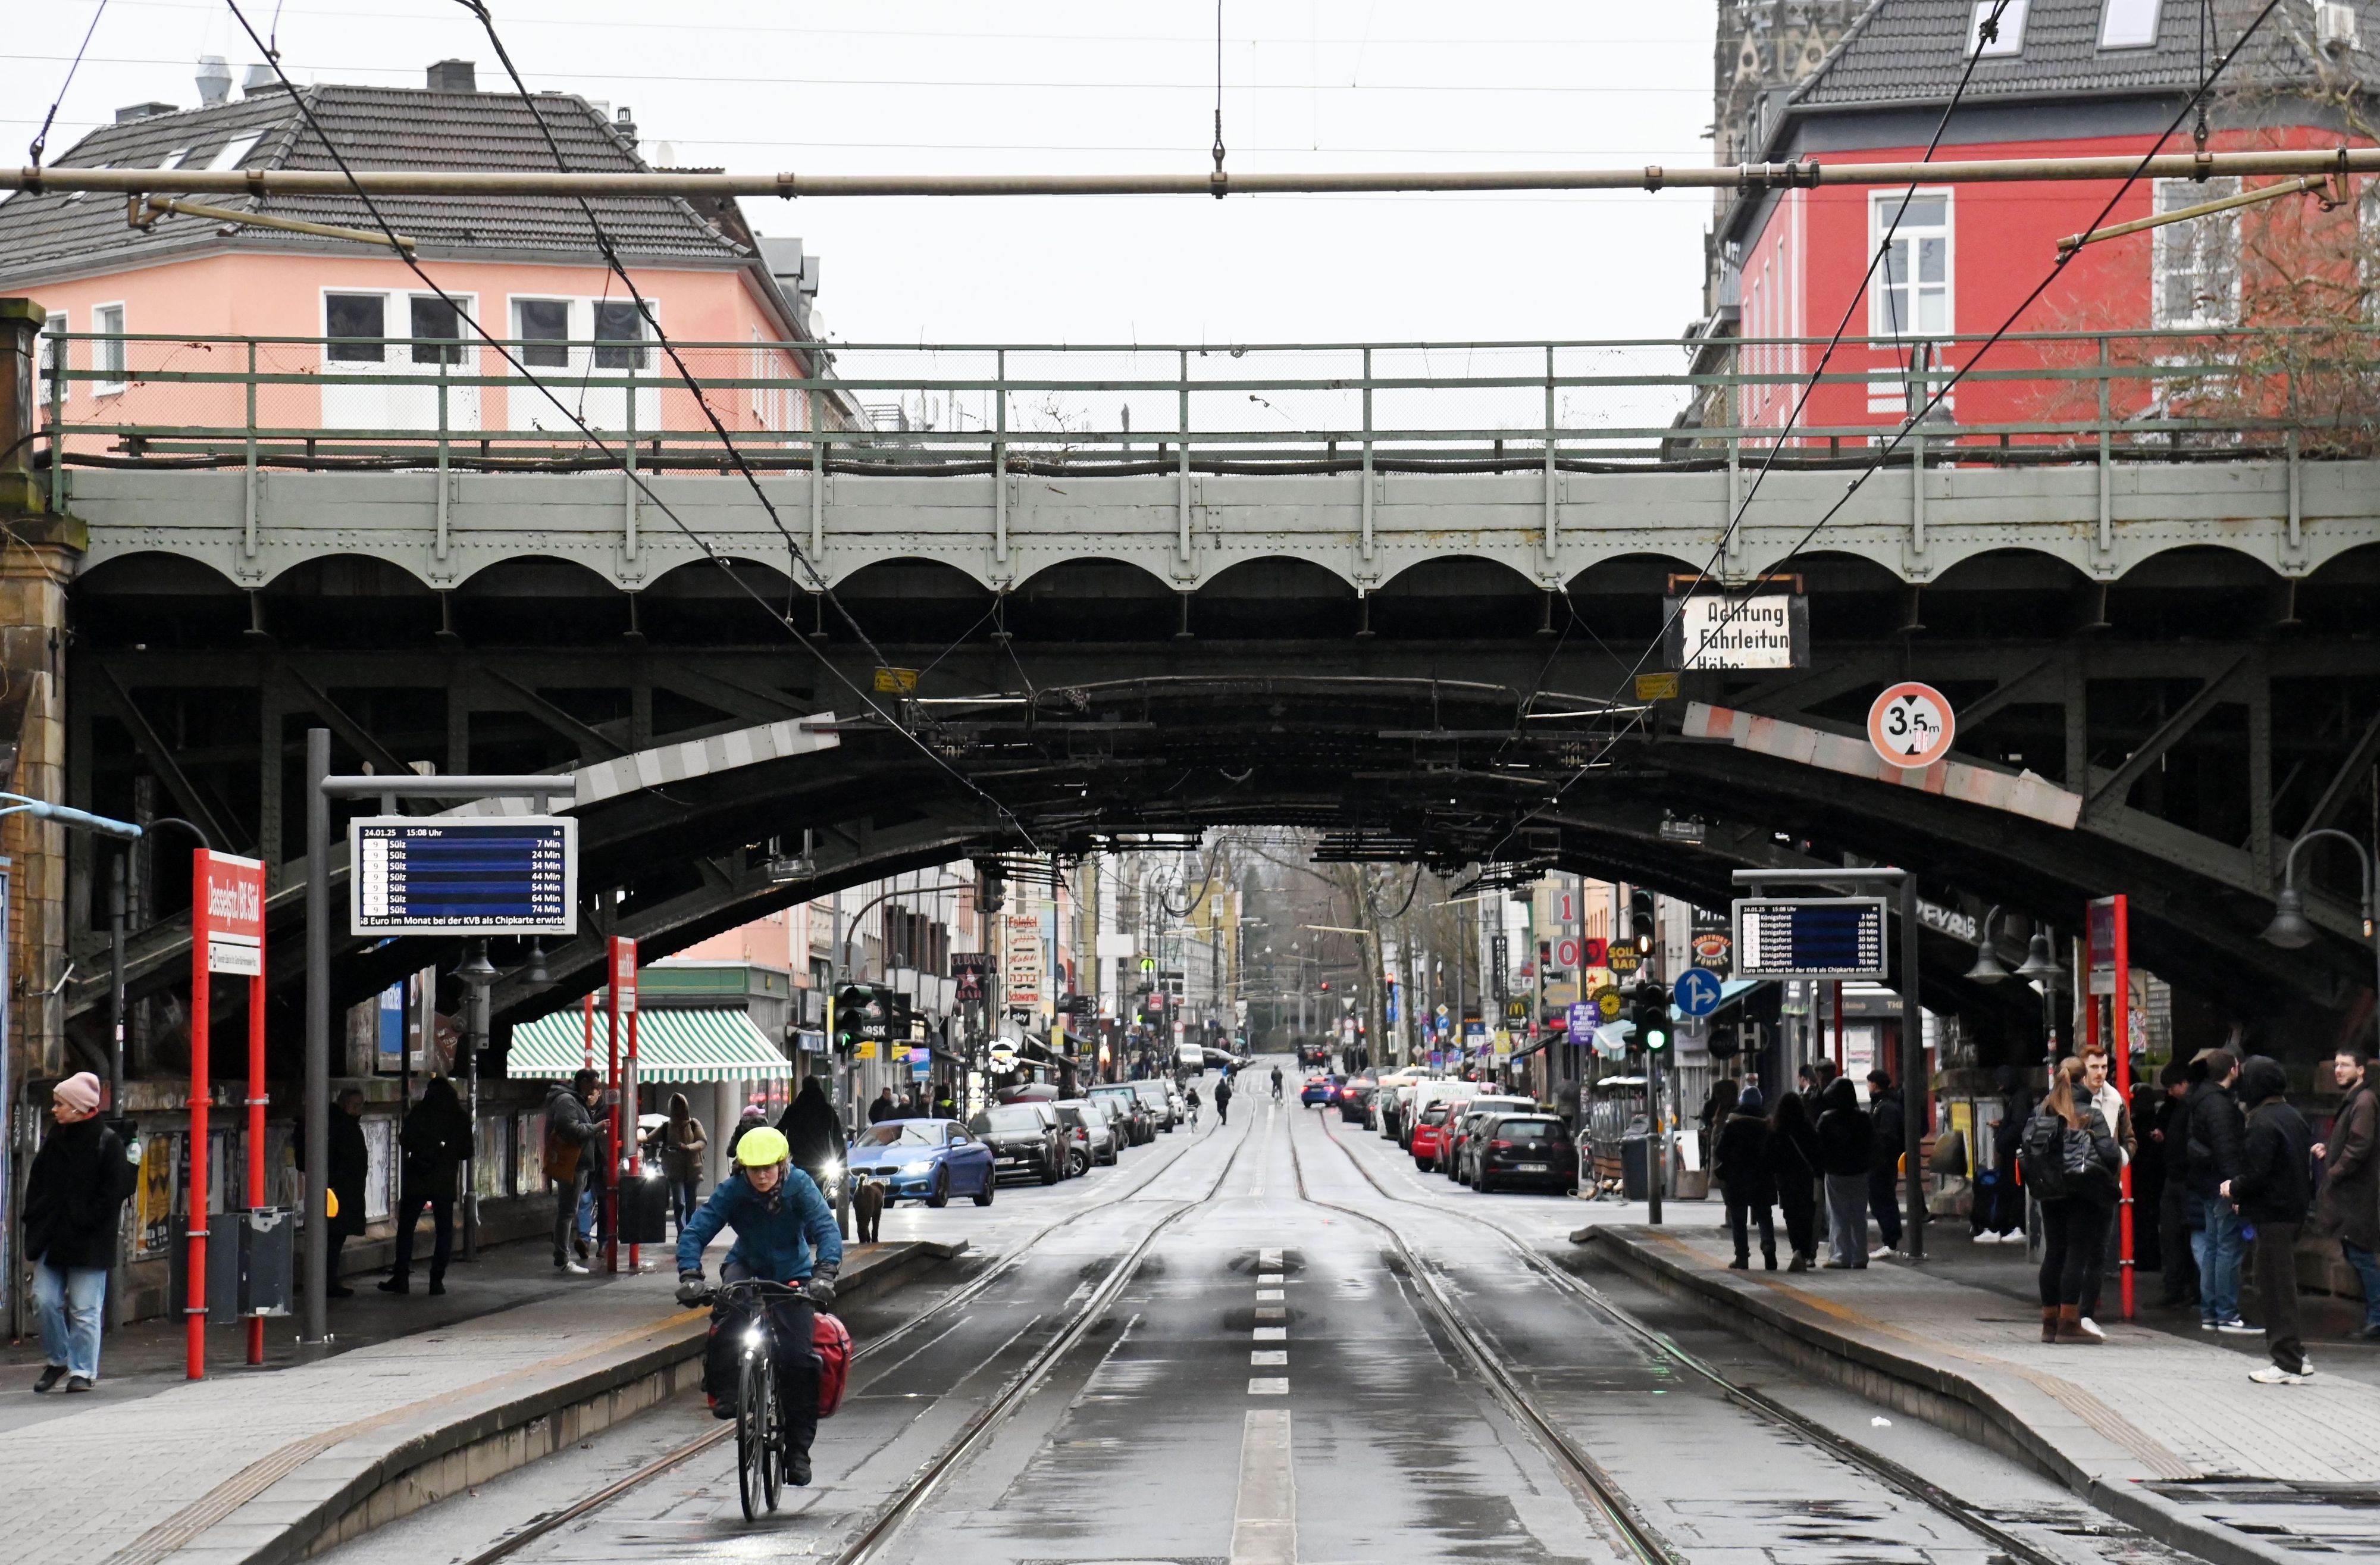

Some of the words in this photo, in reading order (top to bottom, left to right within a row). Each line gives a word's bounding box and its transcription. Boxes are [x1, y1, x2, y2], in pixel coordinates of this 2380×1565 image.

[1708, 601, 1783, 627] Achtung
[1700, 628, 1789, 649] Fahrleitun
[389, 840, 406, 849] Sülz
[537, 840, 543, 848] 7
[544, 840, 560, 848] Min
[389, 851, 406, 859] Sülz
[532, 850, 543, 859] 24
[544, 850, 560, 859] Min
[389, 862, 406, 870] Sülz
[532, 862, 543, 870] 34
[544, 862, 560, 870] Min
[389, 873, 406, 881] Sülz
[532, 872, 543, 881] 44
[544, 872, 560, 881] Min
[389, 884, 406, 892] Sülz
[532, 883, 543, 891] 54
[544, 883, 560, 891] Min
[389, 894, 406, 903] Sülz
[389, 906, 406, 914] Sülz
[532, 905, 543, 913] 74
[544, 905, 560, 913] Min
[433, 916, 446, 925] bei
[447, 916, 462, 925] der
[464, 916, 480, 925] KVB
[482, 916, 493, 925] als
[495, 916, 534, 925] Chipkarte
[536, 916, 565, 925] erwirbt
[1009, 916, 1037, 928] Falafel
[1612, 958, 1637, 969] BAR
[1695, 955, 1729, 966] POMMES
[1009, 990, 1038, 1001] Schawarma
[1012, 1012, 1028, 1023] sky
[1432, 1087, 1463, 1096] DIKON
